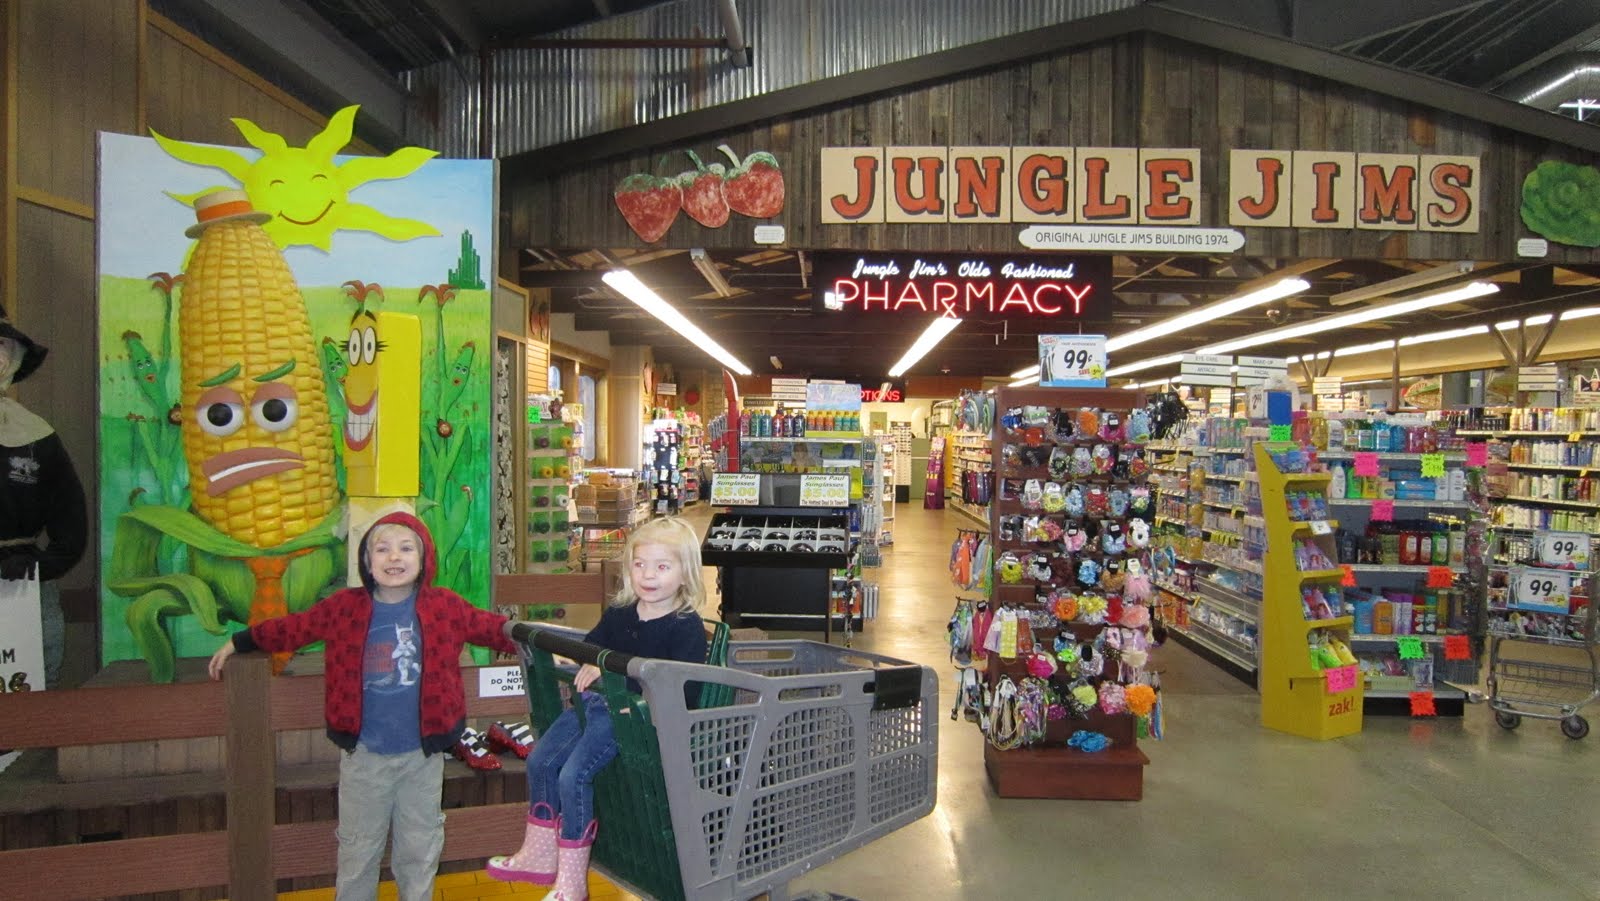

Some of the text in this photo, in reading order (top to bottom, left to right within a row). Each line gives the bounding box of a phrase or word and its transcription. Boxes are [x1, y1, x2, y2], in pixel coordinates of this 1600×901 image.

[830, 153, 1473, 226] JUNGLE JIMS
[1035, 231, 1229, 246] ORIGINAL JUNGLE JIMS BUILDING 1974
[852, 258, 1074, 280] Jungle Jim's Olde Fashioned
[835, 279, 1092, 316] PHARMACY
[714, 486, 757, 497] $5.00
[804, 487, 846, 498] $5.00
[1328, 696, 1355, 717] zak!
